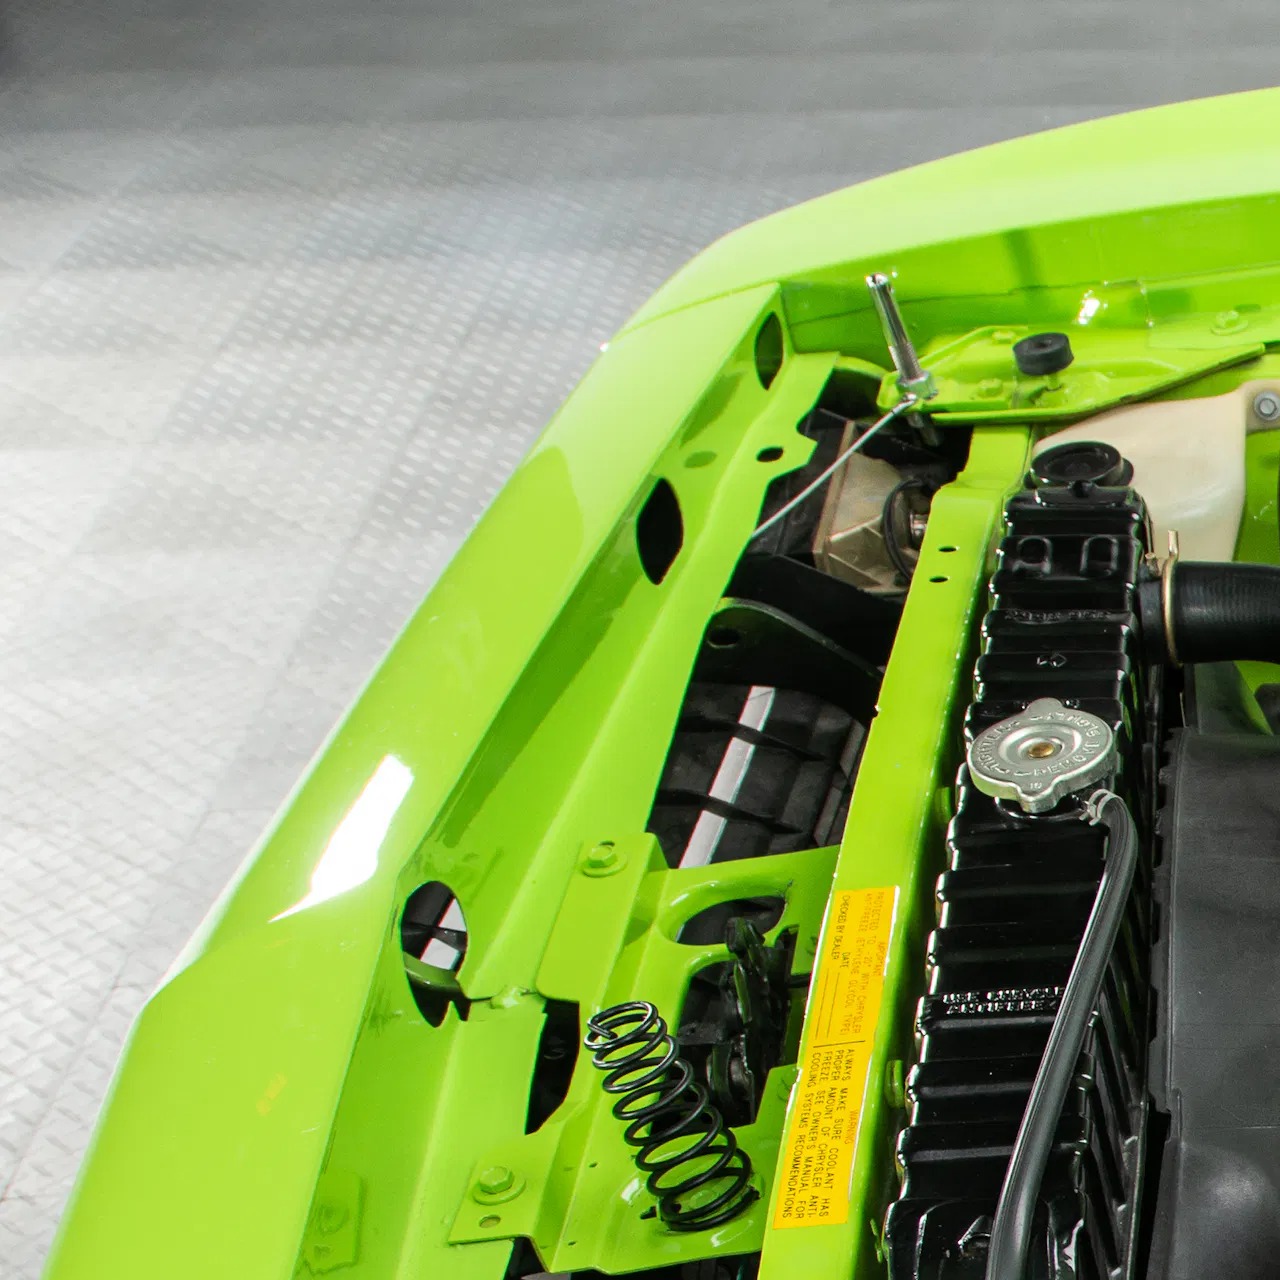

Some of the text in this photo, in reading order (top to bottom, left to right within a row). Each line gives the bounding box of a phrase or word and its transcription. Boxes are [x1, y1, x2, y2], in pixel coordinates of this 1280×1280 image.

[829, 894, 851, 960] CHECKED BY DEALER
[839, 951, 851, 968] DATE
[858, 972, 870, 990] WITH
[850, 994, 866, 1034] CHRYSLER
[829, 1048, 844, 1081] PROPER
[813, 1089, 826, 1105] SEE
[822, 1086, 837, 1120] AMOUNT
[781, 1051, 822, 1219] COOLING SYSTEMS RECOMMENDATIONS
[805, 1110, 822, 1150] OWNER'S
[817, 1048, 855, 1217] ALWAYS MAKE SURE COOLANT HAS
[819, 1125, 831, 1137] OF
[843, 1109, 858, 1145] WARNING
[798, 1155, 814, 1194] MANUAL
[810, 1142, 828, 1188] CHRYSLER
[793, 1200, 806, 1219] FOR
